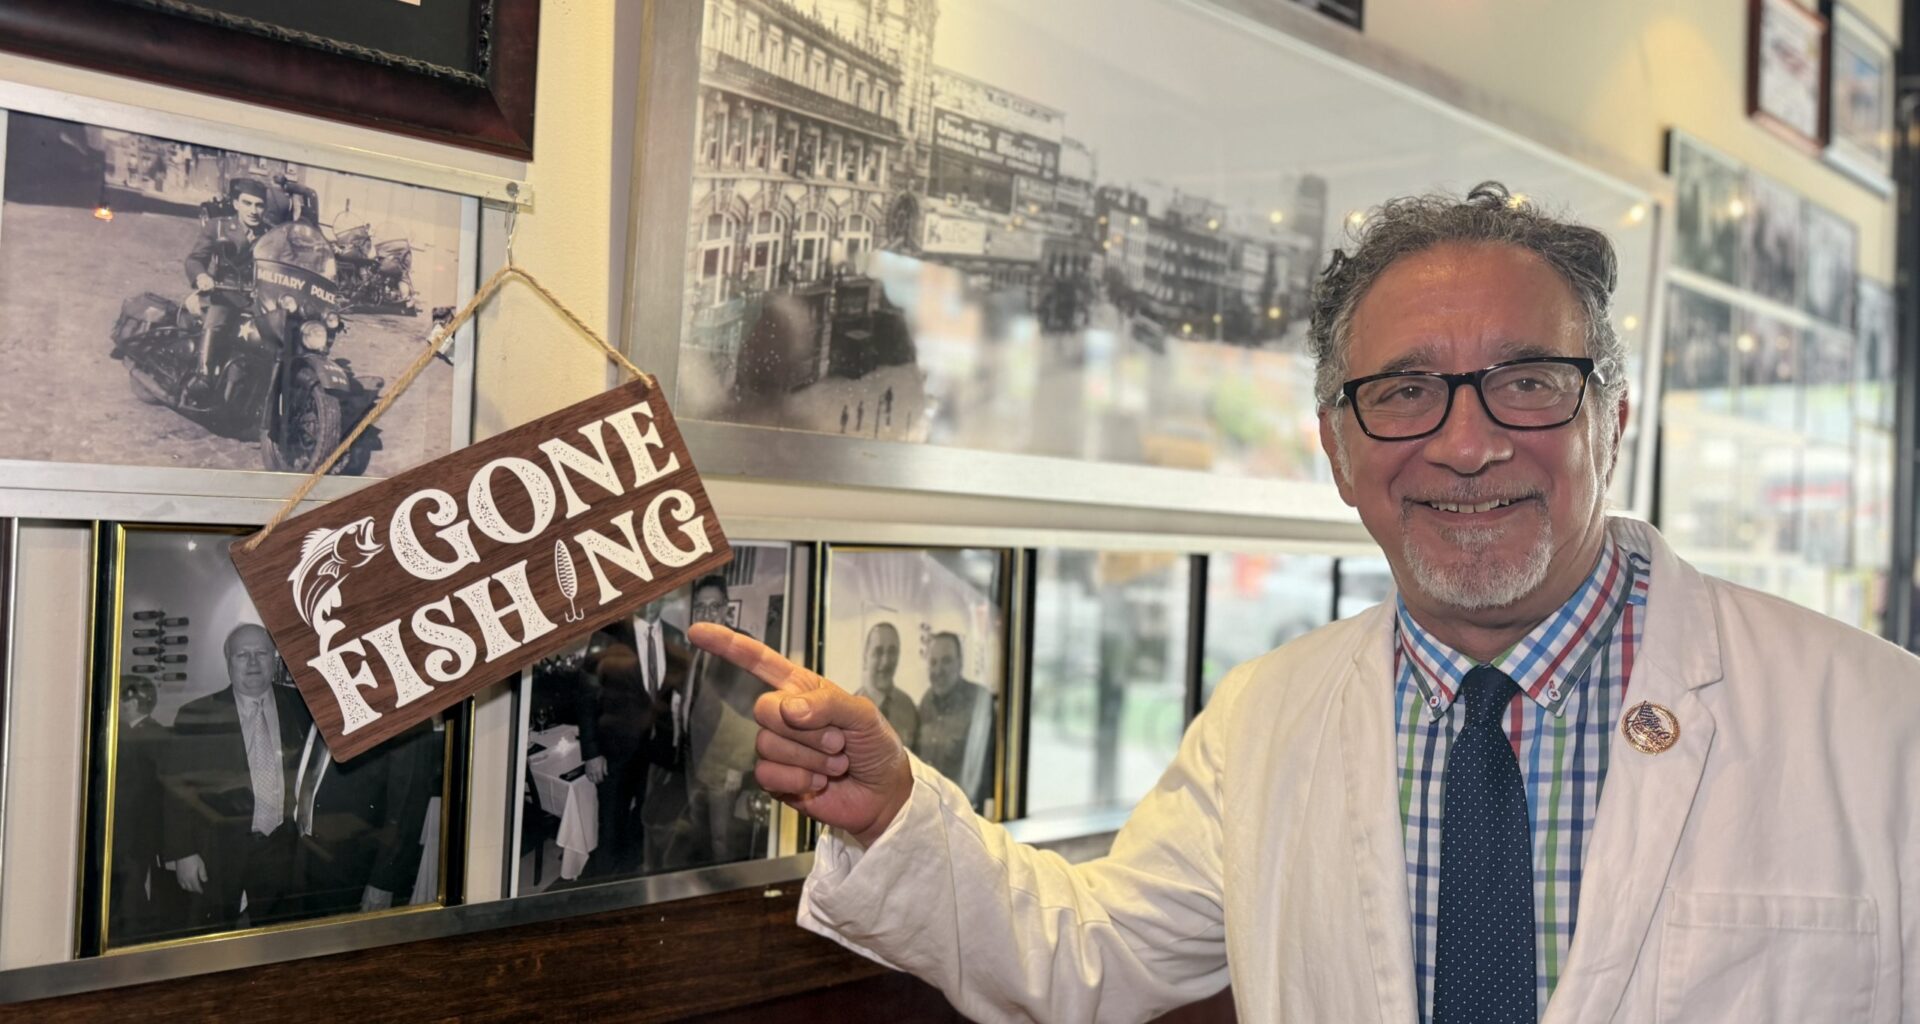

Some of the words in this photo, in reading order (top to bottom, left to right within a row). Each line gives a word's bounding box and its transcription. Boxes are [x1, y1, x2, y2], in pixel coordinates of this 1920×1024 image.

[257, 268, 306, 291] MILITARY
[310, 284, 337, 305] POLICE
[389, 400, 681, 581] GONE
[307, 488, 714, 736] FISHING
